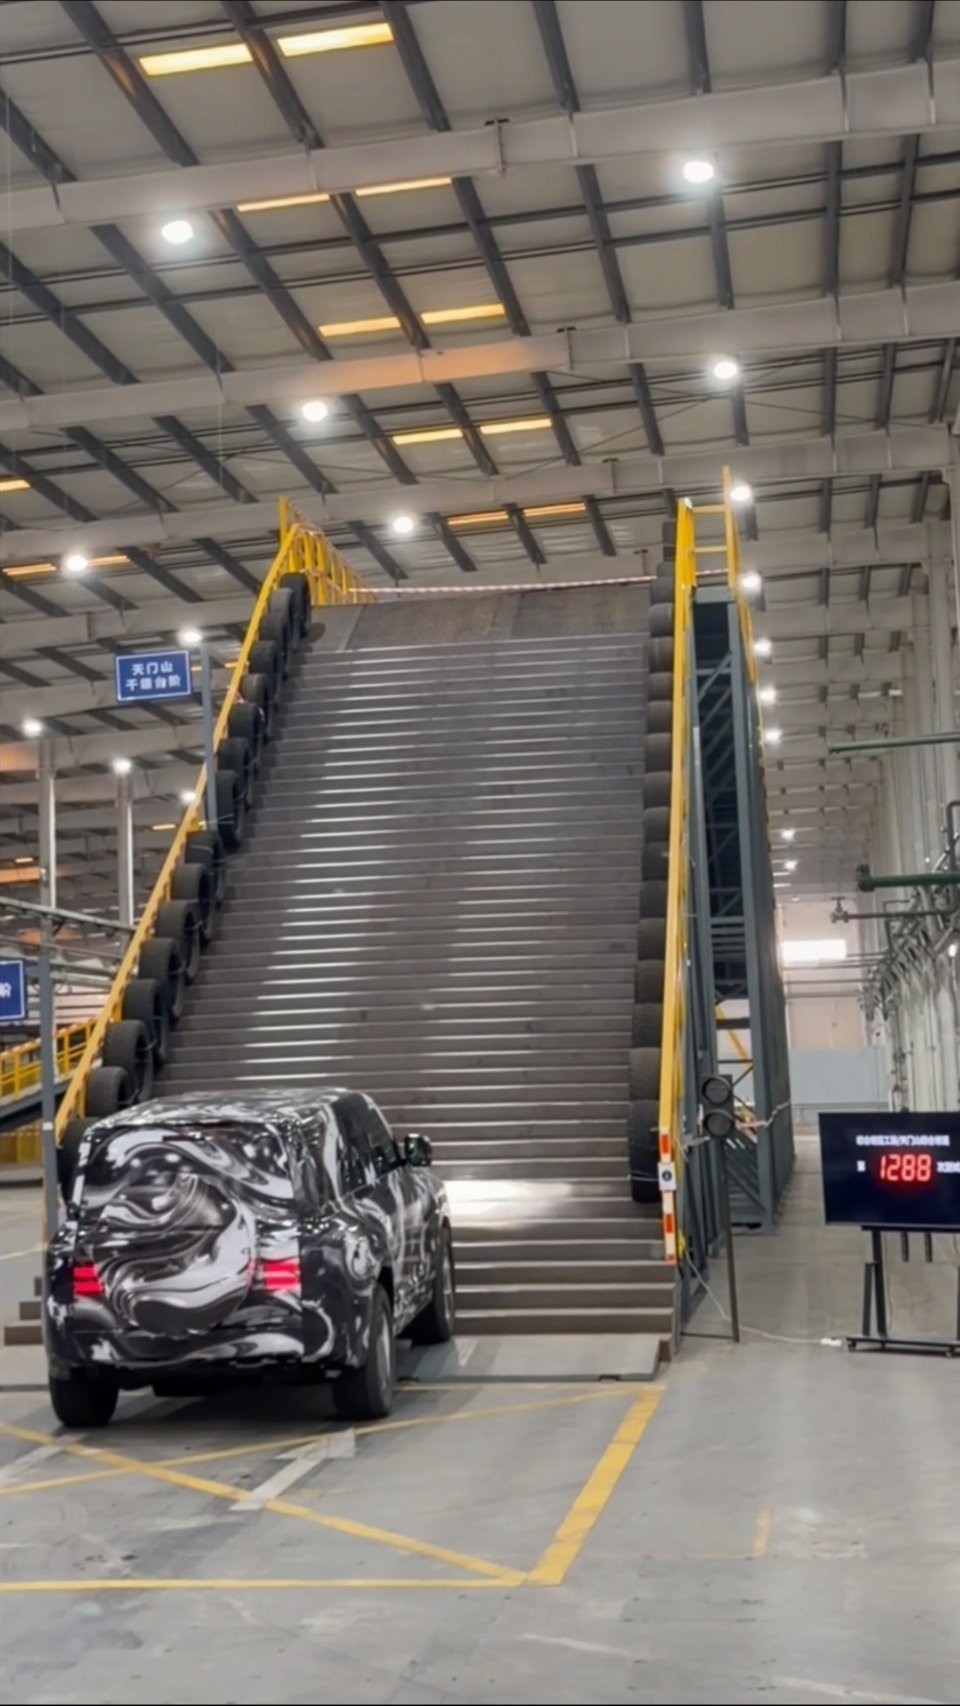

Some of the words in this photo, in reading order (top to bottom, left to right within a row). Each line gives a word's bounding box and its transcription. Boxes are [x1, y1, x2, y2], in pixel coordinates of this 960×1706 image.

[131, 660, 173, 676] 天门山
[880, 1154, 932, 1181] 1288
